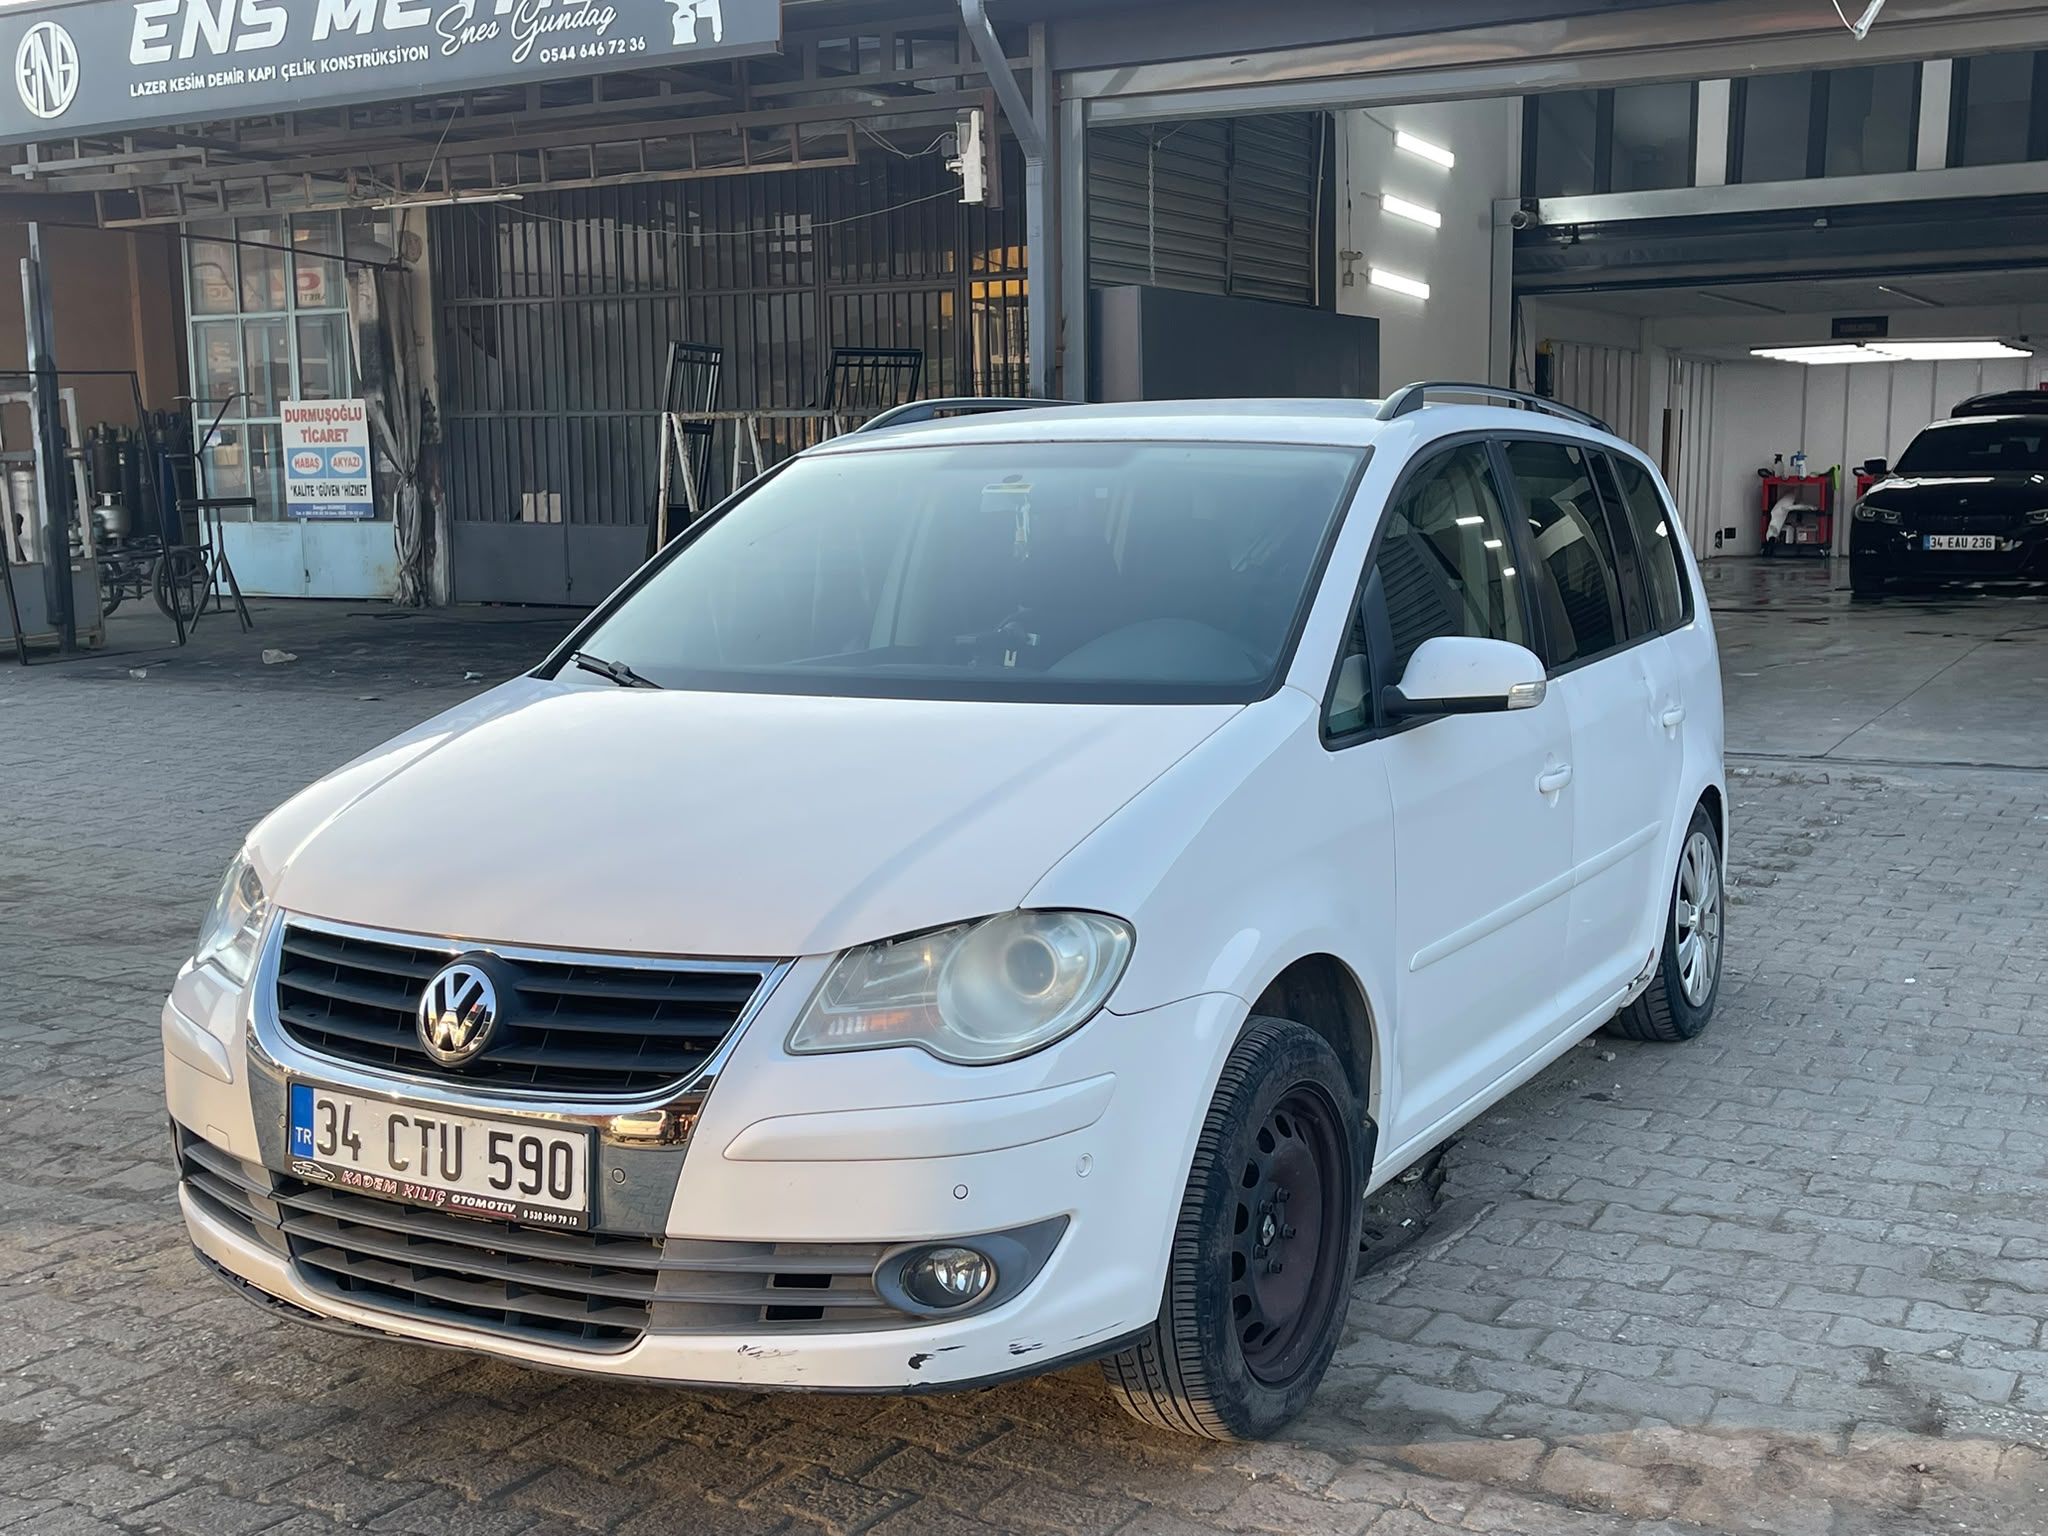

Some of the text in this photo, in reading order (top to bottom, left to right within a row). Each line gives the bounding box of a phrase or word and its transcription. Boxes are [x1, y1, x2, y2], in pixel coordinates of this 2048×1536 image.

[129, 0, 288, 65] ENS
[435, 3, 500, 56] Enes
[540, 36, 646, 63] 0544 646 72 36
[130, 45, 429, 97] LAZER KESİM DEMİR KAPI ÇELİK KONSTRÜKSİYON
[284, 405, 362, 425] DURMUŞOĞLU
[301, 426, 349, 443] TİCARET
[294, 457, 360, 470] HABAŞ AKYAZI
[1930, 537, 1992, 549] 34 EAU 236
[295, 1126, 312, 1145] TR
[316, 1099, 573, 1201] 34 CTU 590
[342, 1170, 398, 1194] KADEM
[402, 1183, 446, 1207] KILIÇ
